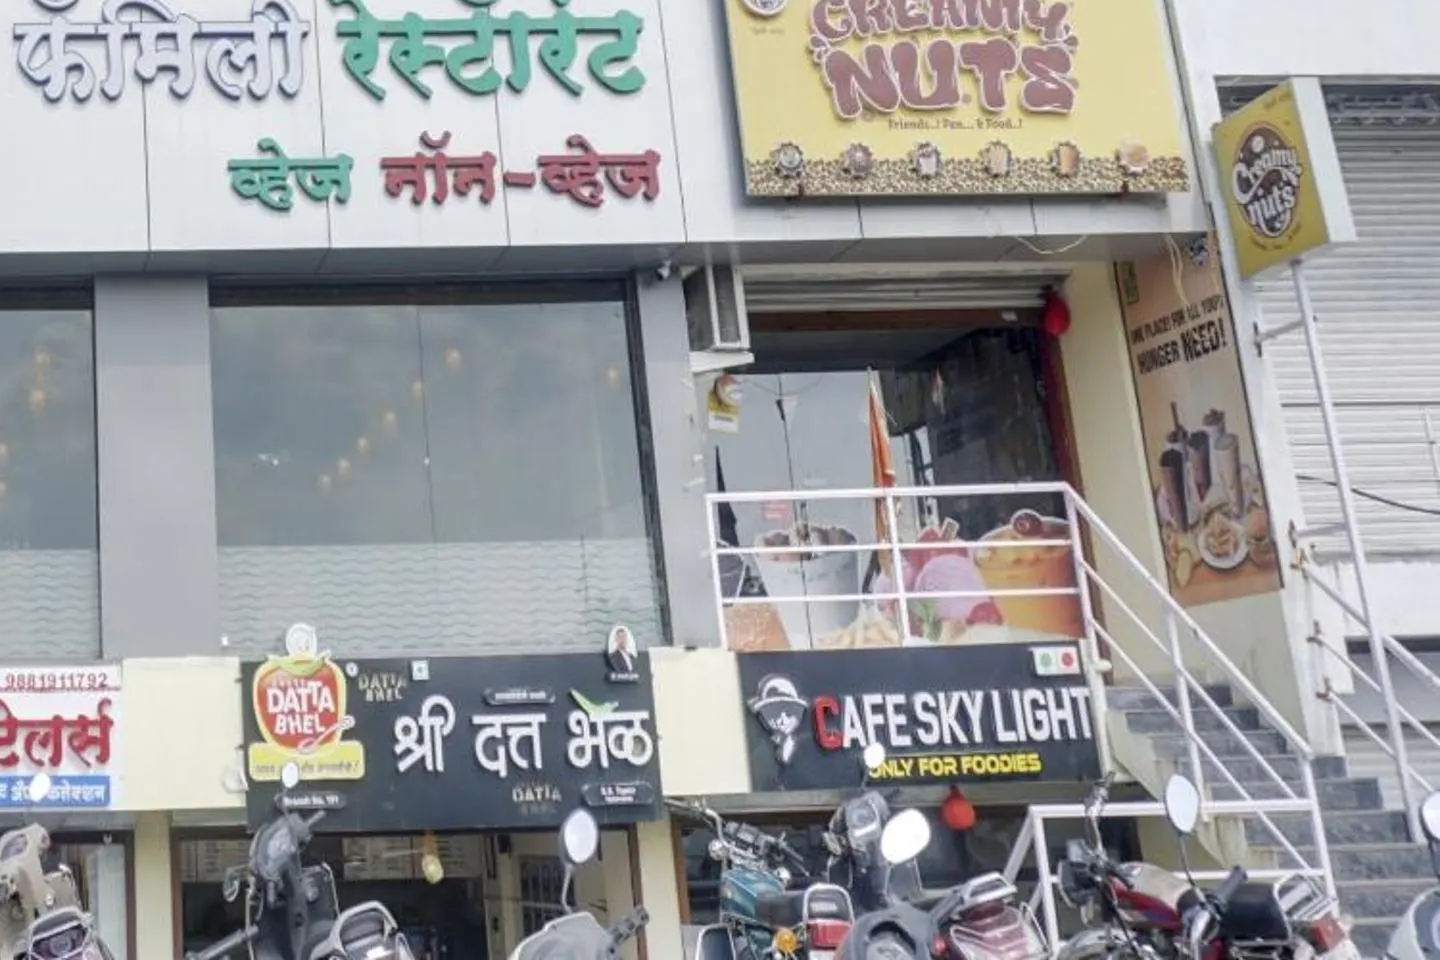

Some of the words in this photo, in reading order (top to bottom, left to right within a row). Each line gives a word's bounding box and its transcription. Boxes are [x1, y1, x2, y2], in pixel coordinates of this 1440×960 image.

[822, 38, 1076, 119] NUTS
[227, 137, 354, 212] व्हेज
[1232, 148, 1302, 206] Creamy
[1247, 185, 1296, 229] nuts
[266, 681, 335, 714] DATTA
[274, 712, 327, 736] BHEL
[813, 692, 912, 749] CAFE
[915, 690, 986, 744] SKY
[991, 686, 1093, 743] LIGHT
[393, 695, 456, 774] श्री
[472, 713, 547, 778] दत्त
[918, 756, 959, 776] FOR
[961, 752, 1042, 775] FOODIES
